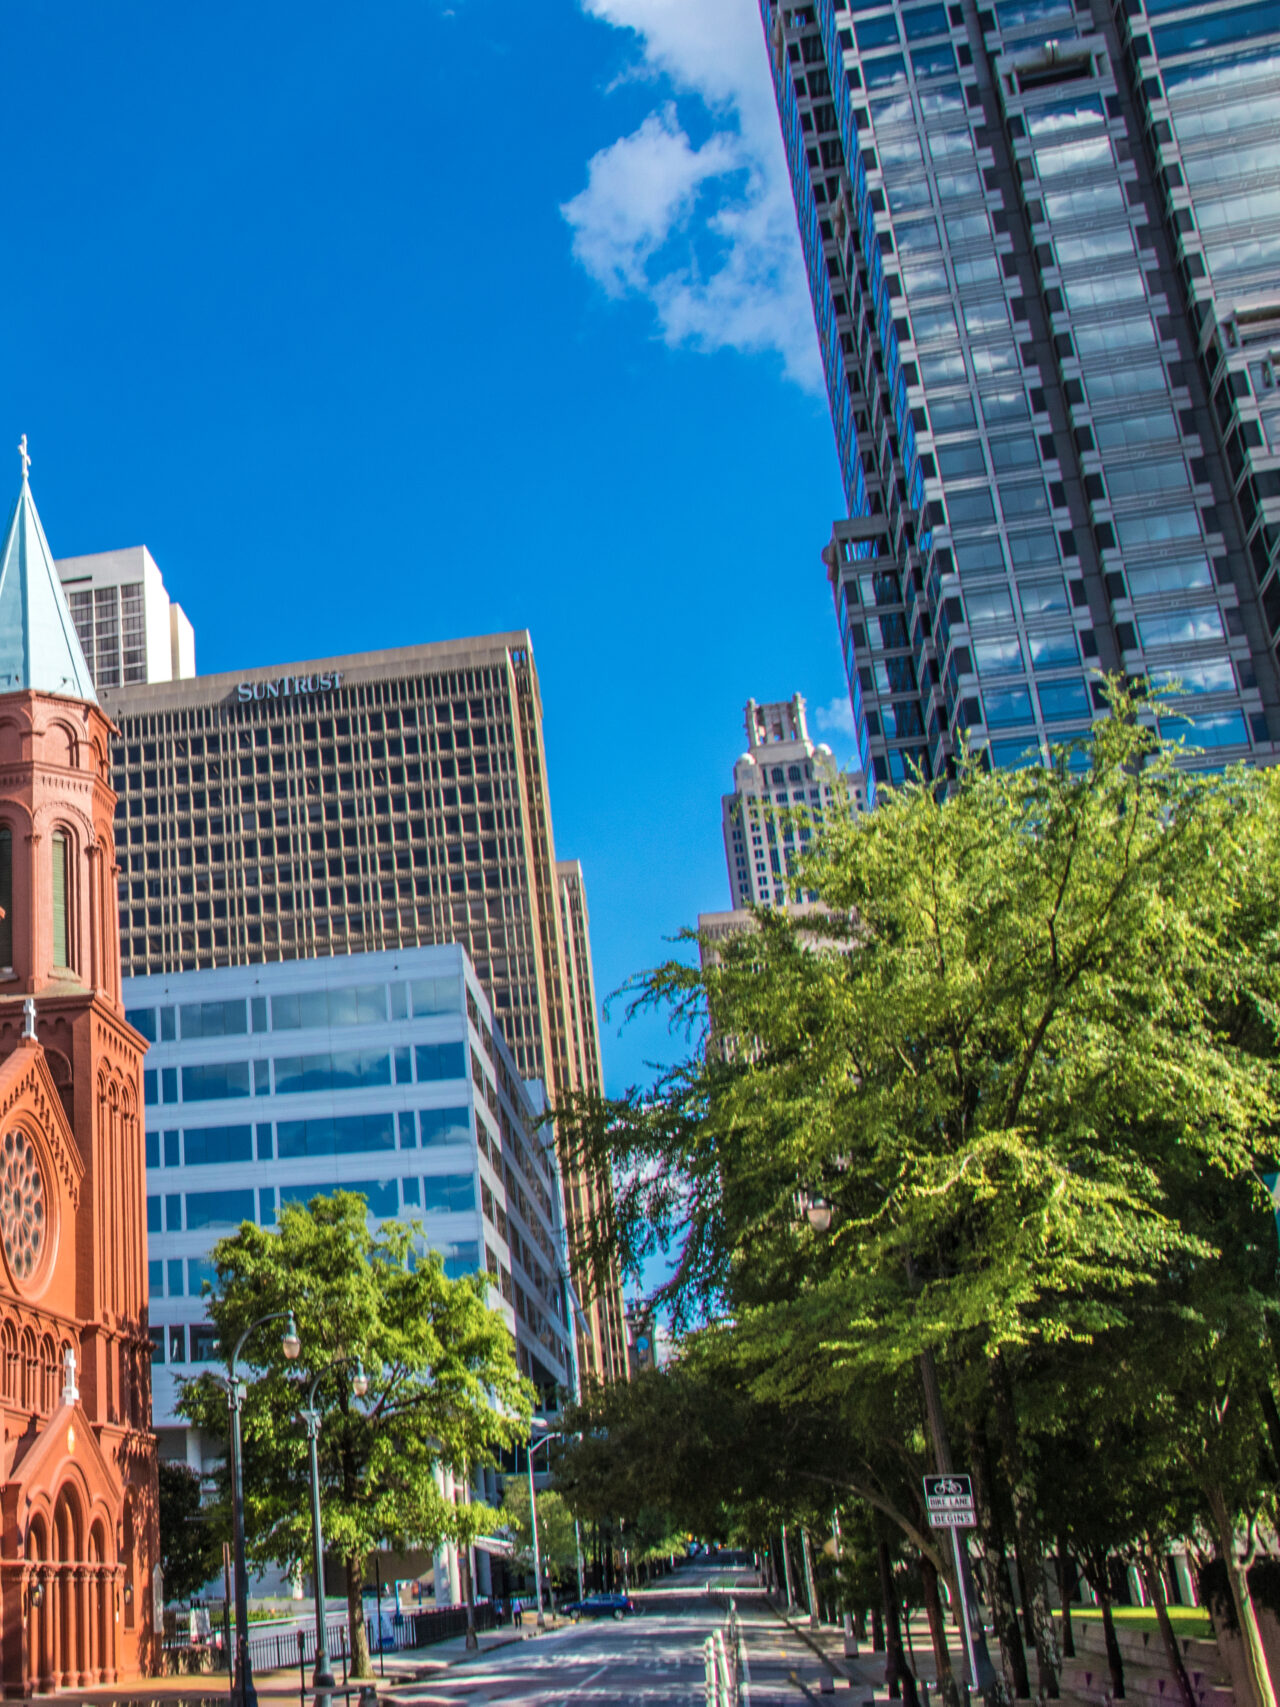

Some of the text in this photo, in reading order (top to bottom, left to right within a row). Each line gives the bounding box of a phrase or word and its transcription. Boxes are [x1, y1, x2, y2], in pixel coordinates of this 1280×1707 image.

[930, 1496, 969, 1506] BIKE LANE
[934, 1513, 971, 1524] BEGINS
